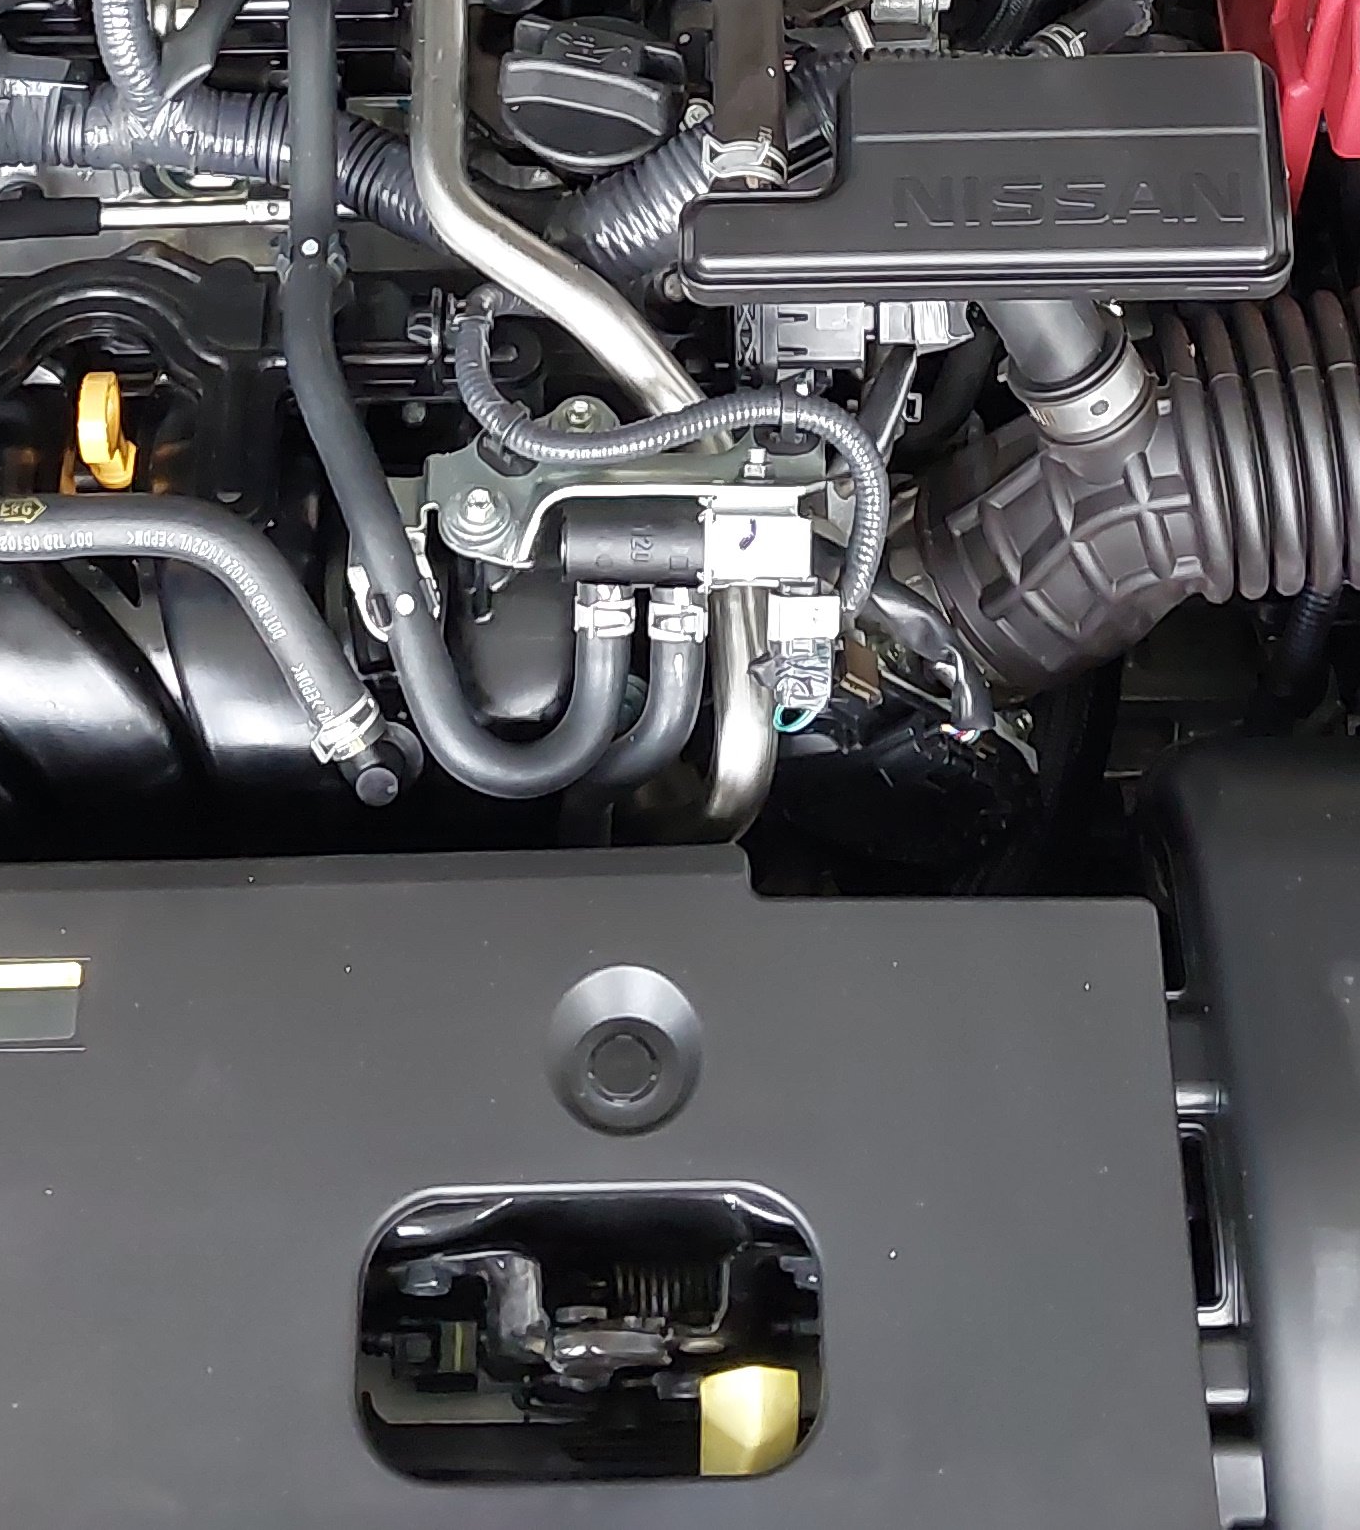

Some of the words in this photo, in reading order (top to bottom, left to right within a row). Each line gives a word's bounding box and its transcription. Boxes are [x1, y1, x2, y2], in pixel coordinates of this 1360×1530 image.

[893, 172, 1245, 227] NISSAN
[70, 531, 93, 548] DOT
[219, 555, 259, 598] 051024
[262, 615, 288, 642] DOT
